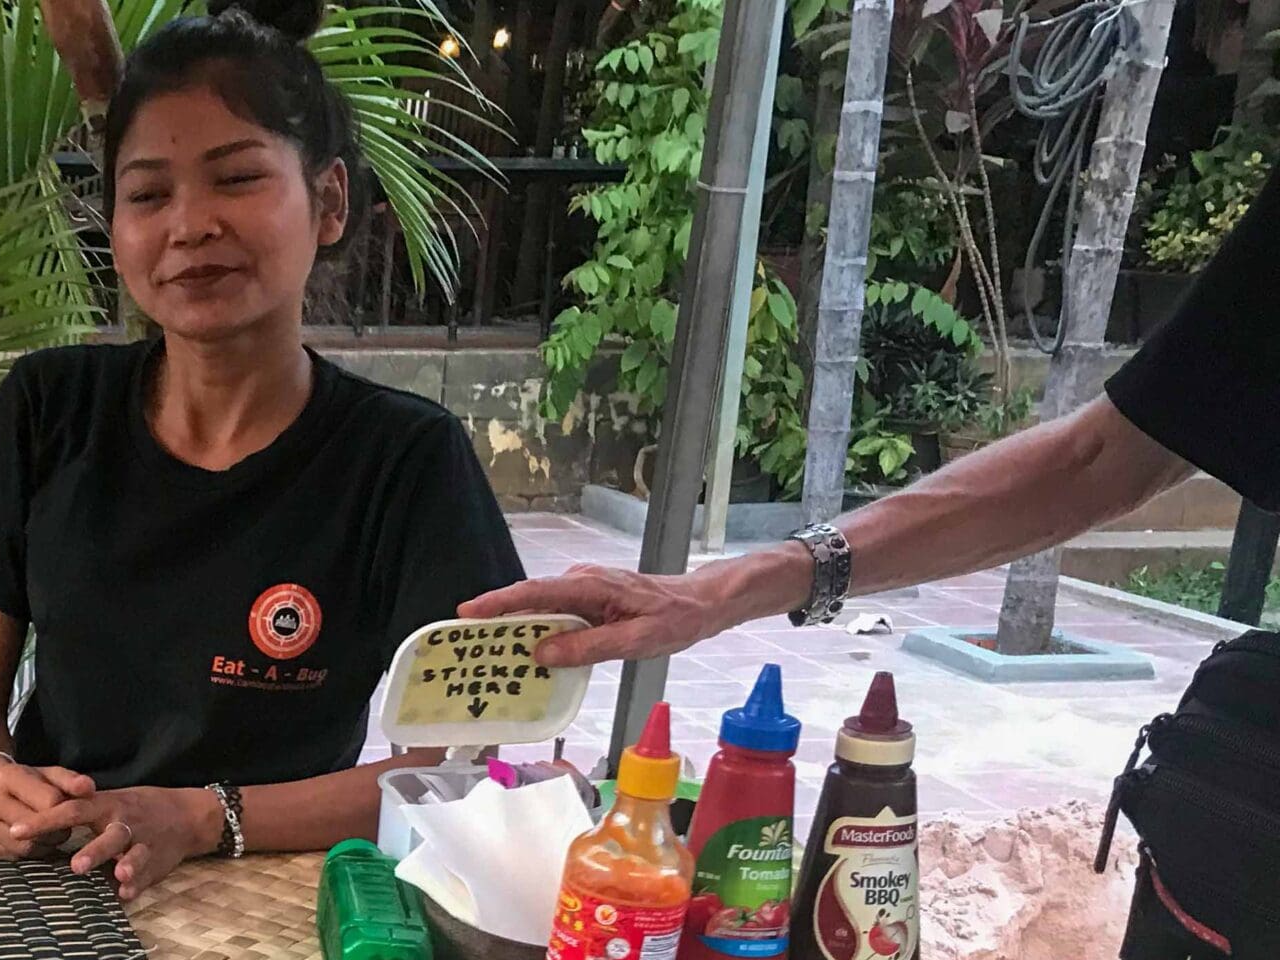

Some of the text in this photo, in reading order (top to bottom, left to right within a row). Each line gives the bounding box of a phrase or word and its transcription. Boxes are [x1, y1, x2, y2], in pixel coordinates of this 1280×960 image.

[427, 624, 551, 646] COLLECT
[453, 642, 531, 662] YOUR
[211, 656, 246, 676] Eat
[264, 664, 278, 681] A
[296, 667, 328, 683] Bug
[422, 664, 551, 683] STICKER
[445, 681, 522, 698] HERE
[840, 826, 914, 843] MasterFoods
[726, 844, 792, 861] Founta
[850, 871, 911, 890] Smokey
[864, 888, 900, 907] BBQ
